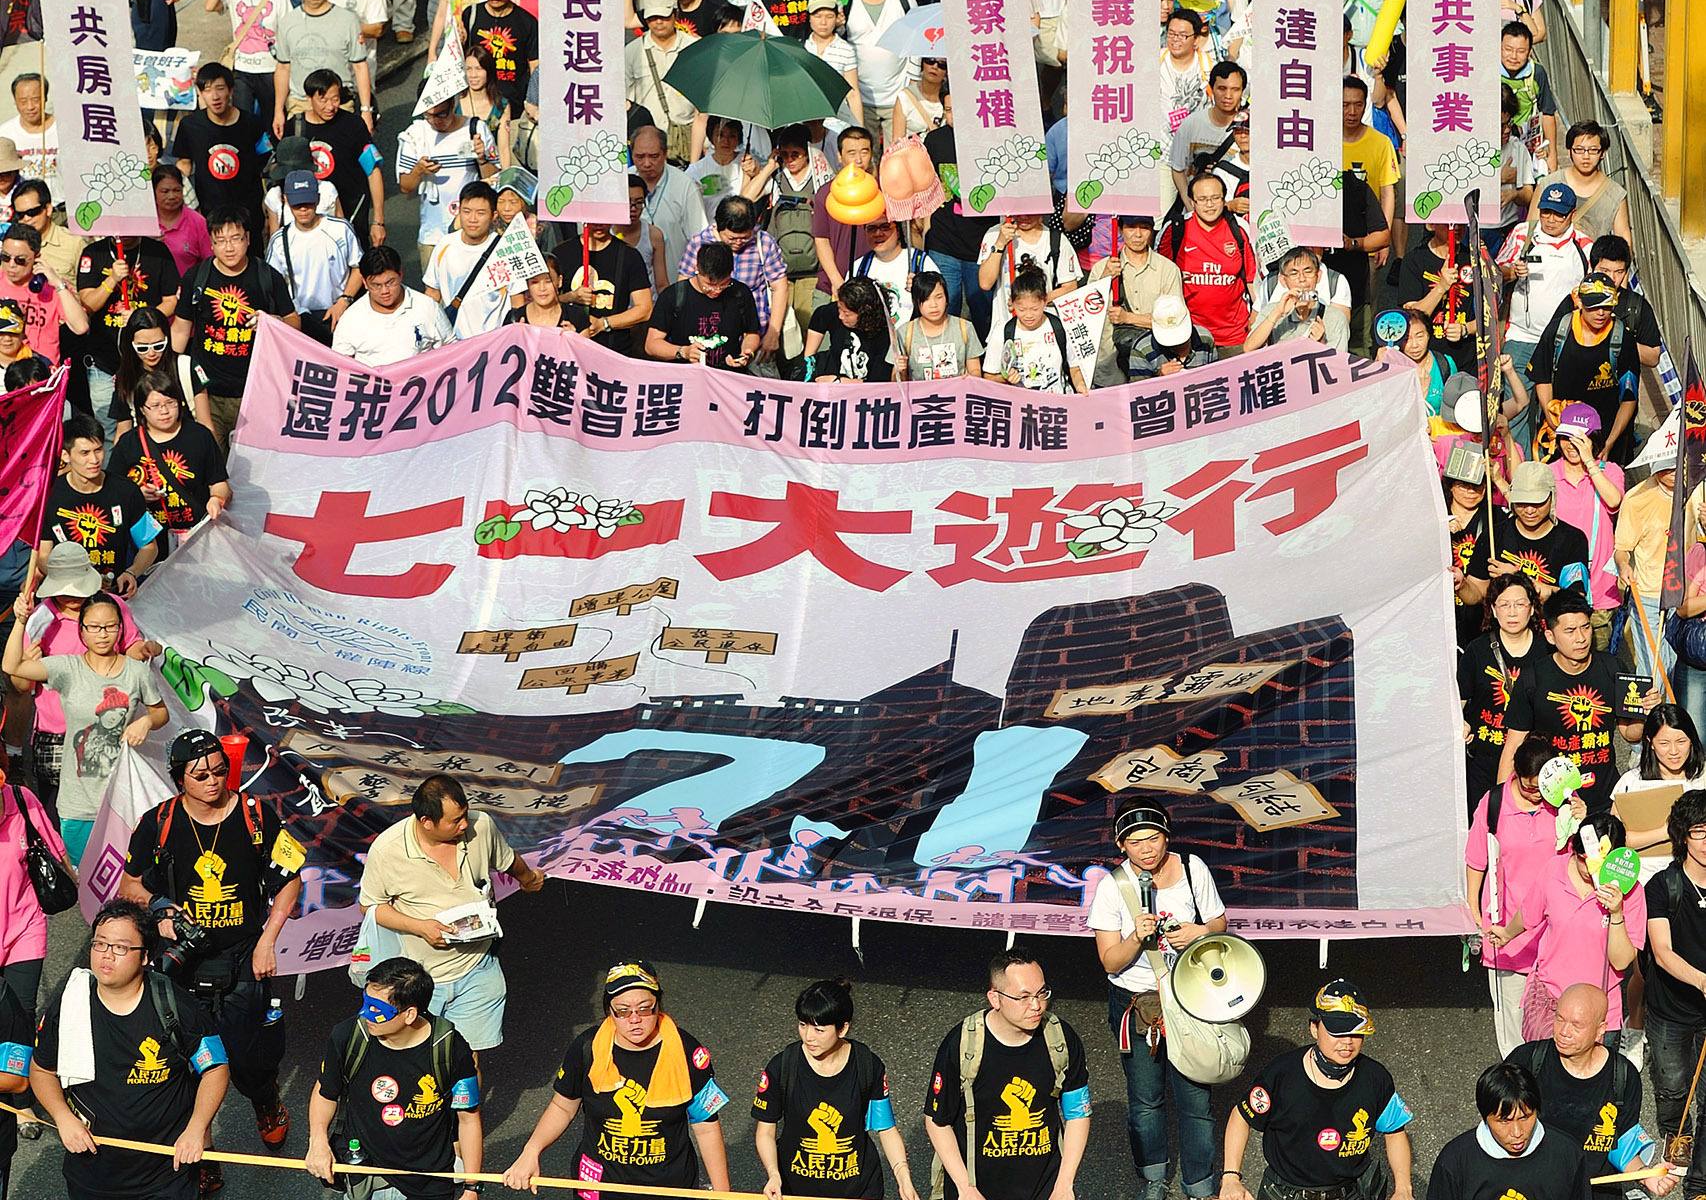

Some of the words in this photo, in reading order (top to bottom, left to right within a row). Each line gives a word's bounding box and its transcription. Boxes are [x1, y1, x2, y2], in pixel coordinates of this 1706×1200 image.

[1202, 261, 1223, 274] Fly
[280, 344, 684, 442] 還我2012雙普選
[743, 387, 1069, 452] 打倒地產霸權
[252, 587, 282, 601] Civil
[357, 617, 414, 642] Rights
[241, 598, 433, 677] 民間人權陣線
[1551, 730, 1611, 750] 地產霸權
[183, 900, 245, 919] 人民力量
[213, 917, 244, 928] POWER
[597, 1132, 667, 1157] 人民力量
[982, 1126, 1052, 1148] 人民力量
[629, 1154, 667, 1167] POWER
[982, 1145, 1018, 1159] PEOPLE
[1018, 1143, 1053, 1158] POWER
[790, 1150, 859, 1173] 人民力量
[790, 1163, 826, 1181] PEOPLE
[826, 1166, 862, 1181] POWER
